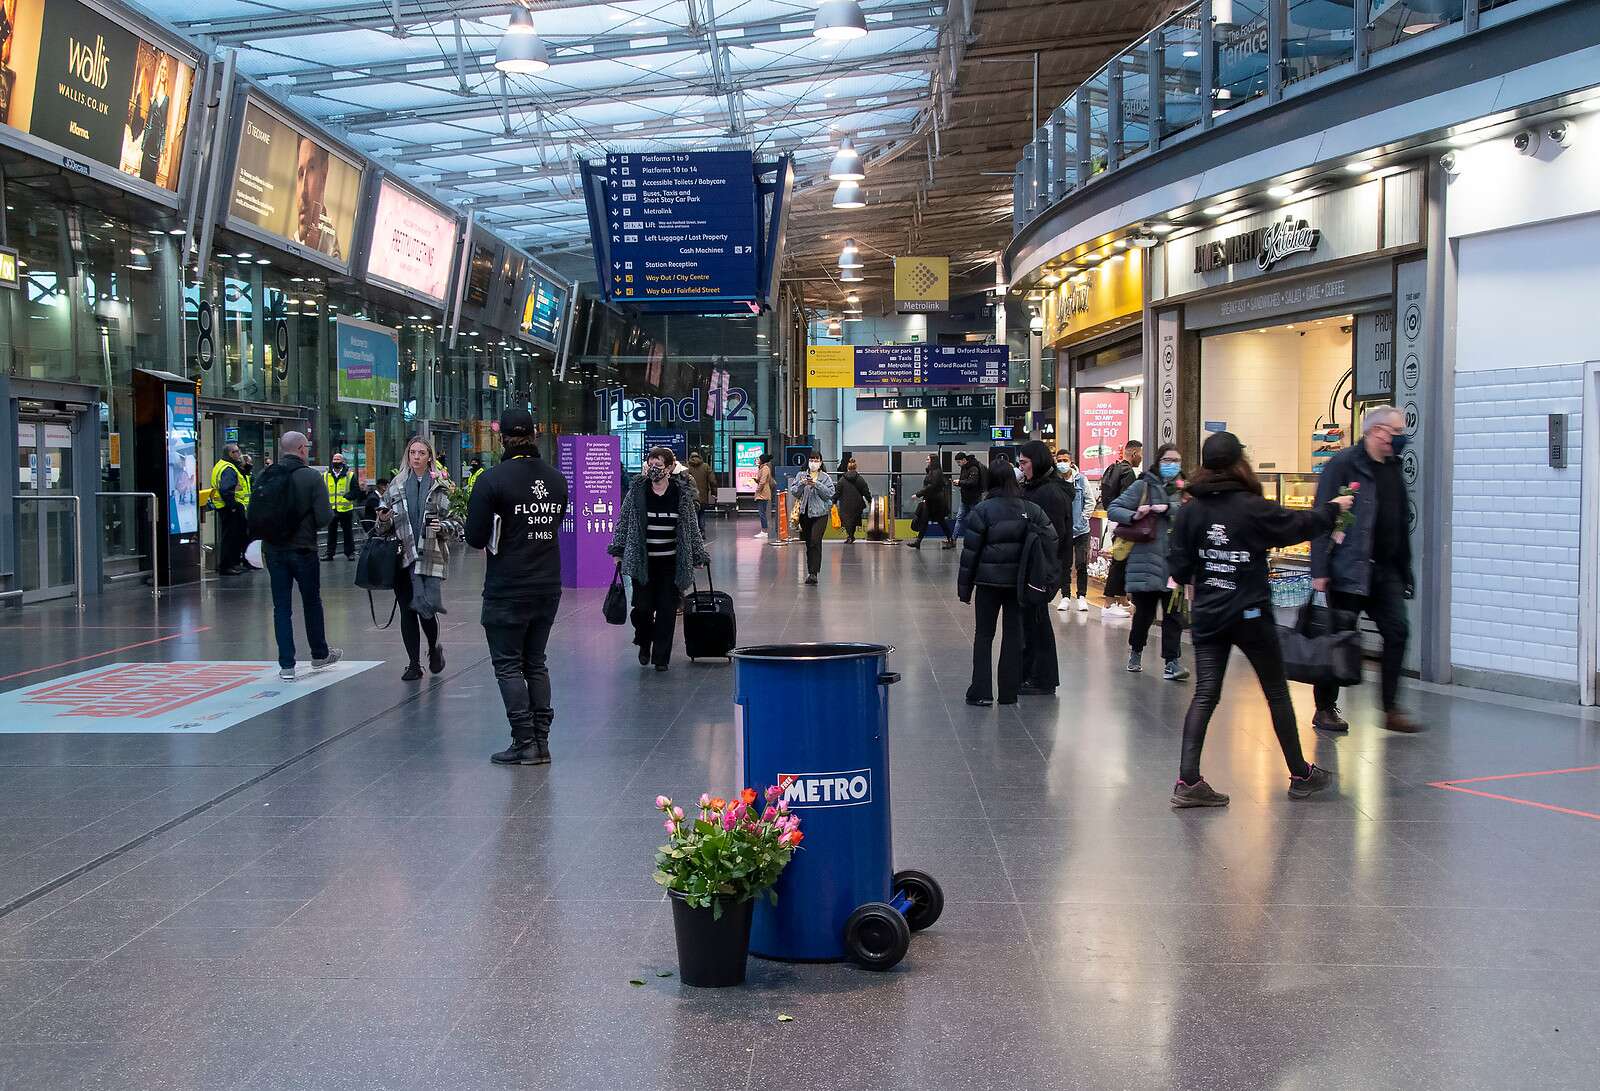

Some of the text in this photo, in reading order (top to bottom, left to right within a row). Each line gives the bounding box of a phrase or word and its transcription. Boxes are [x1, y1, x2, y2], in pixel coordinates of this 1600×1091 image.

[1228, 18, 1256, 43] The Food
[1219, 30, 1267, 64] Terrace
[68, 34, 110, 90] wallis
[58, 82, 110, 116] WALLIS.CO.UK
[1256, 220, 1315, 271] Kitchen
[1285, 288, 1301, 304] SALAD
[1306, 284, 1321, 301] CAKE
[1325, 280, 1344, 297] COFFEE
[1375, 312, 1392, 332] PRO
[198, 300, 214, 371] 8
[1375, 342, 1392, 361] BRIT
[594, 388, 748, 422] 11 and 12
[883, 394, 1029, 408] Lift Lift Lift Lift Lif Lift
[950, 416, 972, 430] Lift
[515, 503, 561, 514] FLOWER
[528, 516, 553, 524] SHOP
[1198, 549, 1250, 562] LOWER
[780, 776, 793, 790] FREE
[784, 776, 867, 802] METRO
